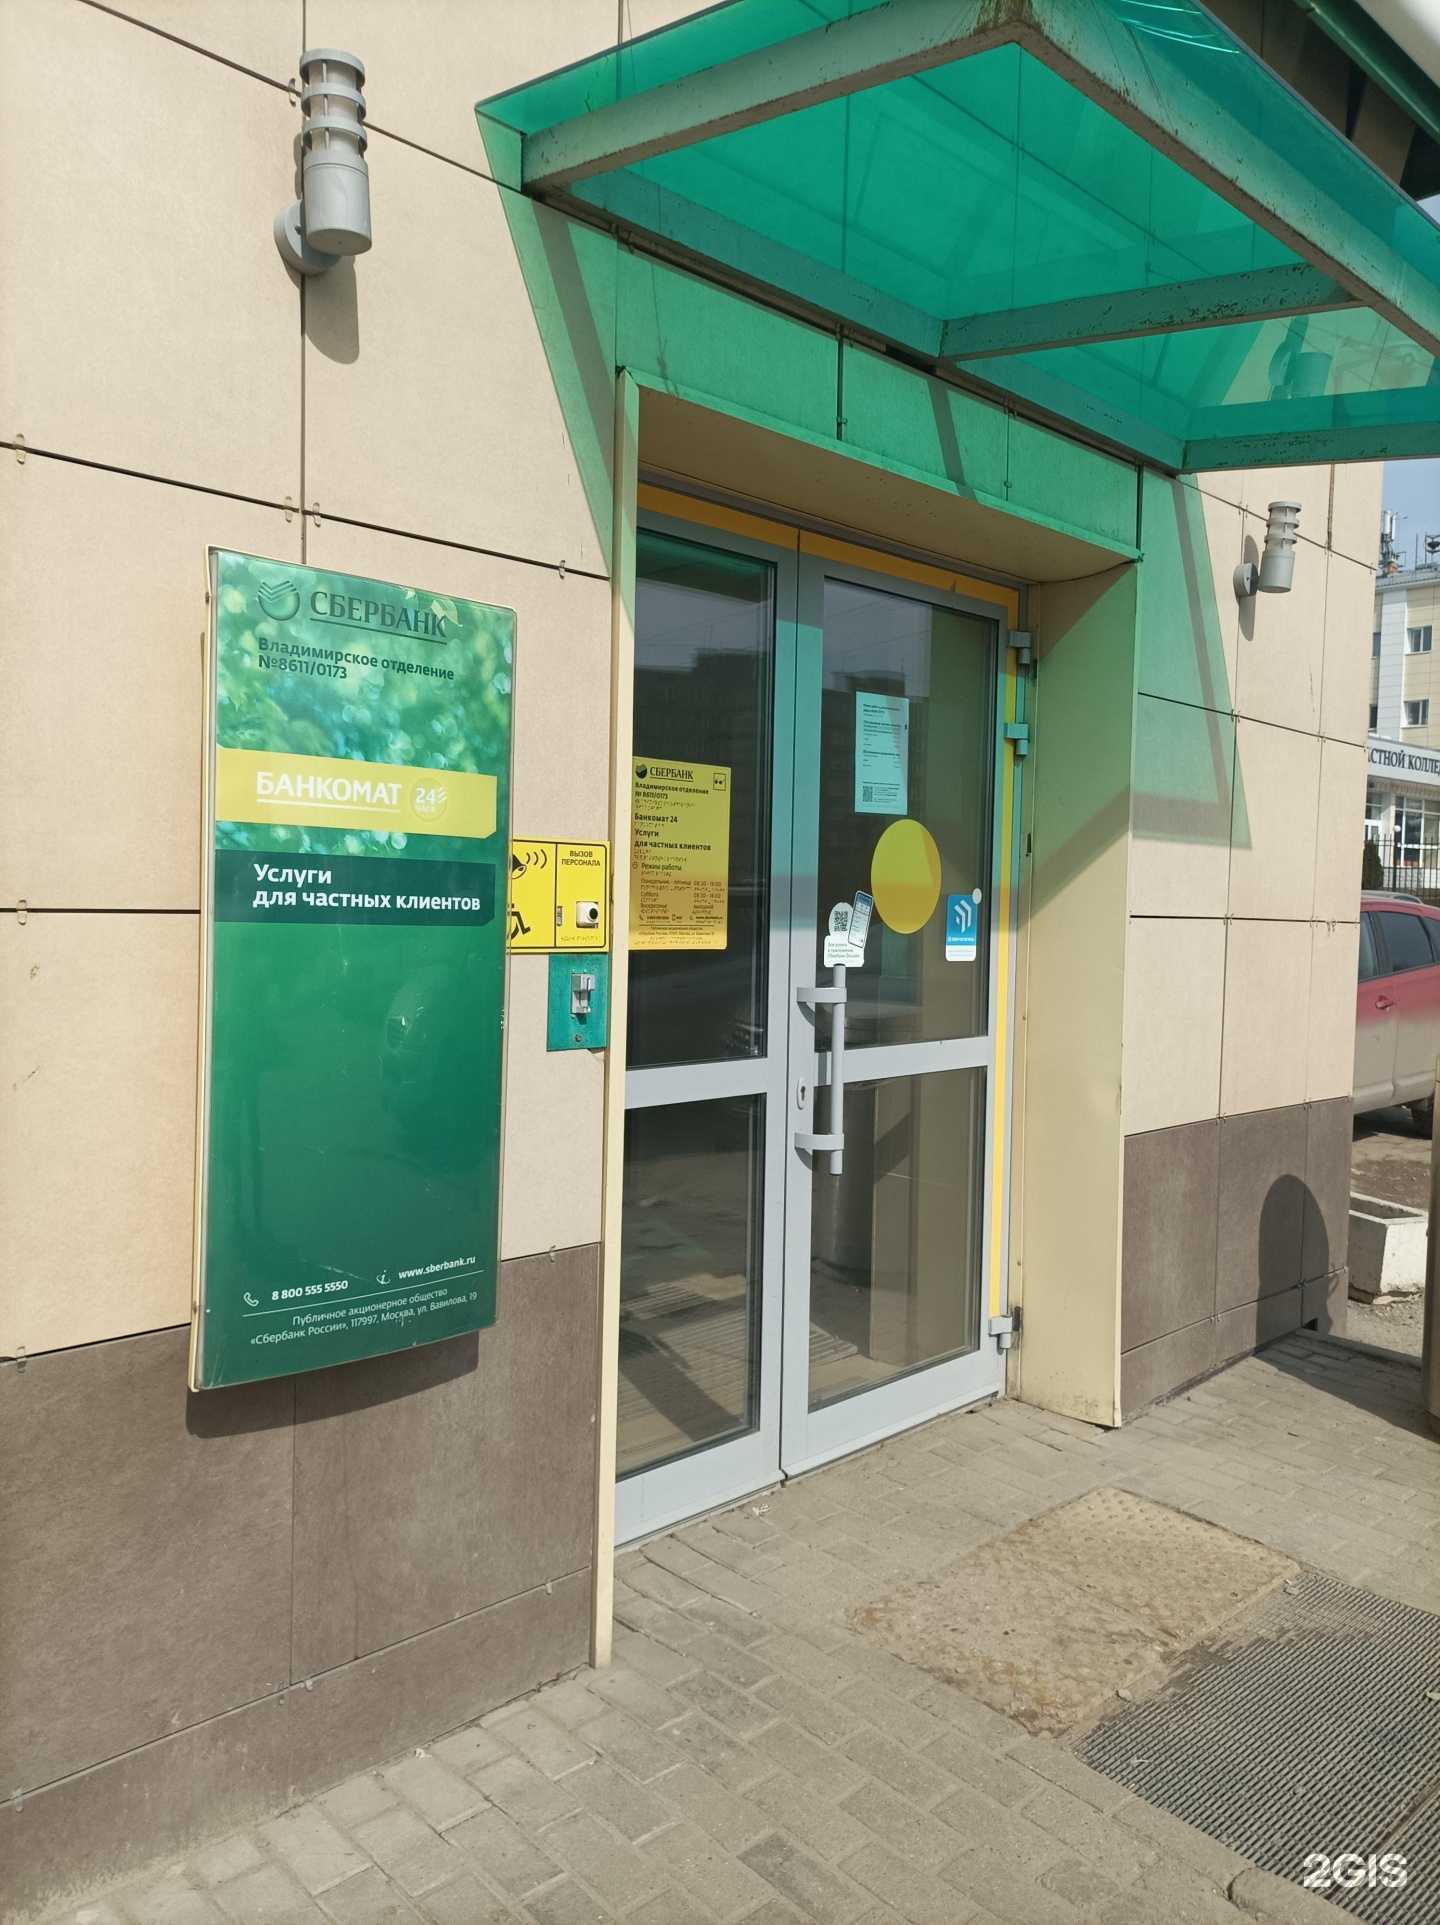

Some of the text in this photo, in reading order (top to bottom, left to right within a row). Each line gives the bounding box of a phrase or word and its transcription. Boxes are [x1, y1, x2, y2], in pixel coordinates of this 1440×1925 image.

[310, 591, 448, 638] СБЕРБАНК
[258, 637, 455, 681] Владимирское отделение
[258, 654, 348, 680] №8611/0173
[1368, 748, 1405, 768] СТНОЙ
[650, 766, 694, 780] СБЕРБАНК
[255, 771, 402, 806] БАНКОМАТ
[415, 787, 436, 804] 24
[634, 813, 678, 824] Банкомат 24
[634, 829, 659, 839] Услуги
[569, 850, 593, 858] ВЫЗОВ
[634, 840, 711, 851] для частных клиентов
[561, 858, 601, 867] ПЕРСОНАЛА
[253, 863, 333, 888] Услуги
[252, 888, 481, 911] для частных клиентов
[398, 1255, 476, 1280] www.sberbank.ru
[271, 1280, 349, 1301] 8 800 555 5550
[292, 1288, 448, 1326] Публичное акционерное общество
[250, 1329, 306, 1345] «Сбербанк
[381, 1307, 416, 1322] Москва,
[417, 1305, 427, 1318] ул.
